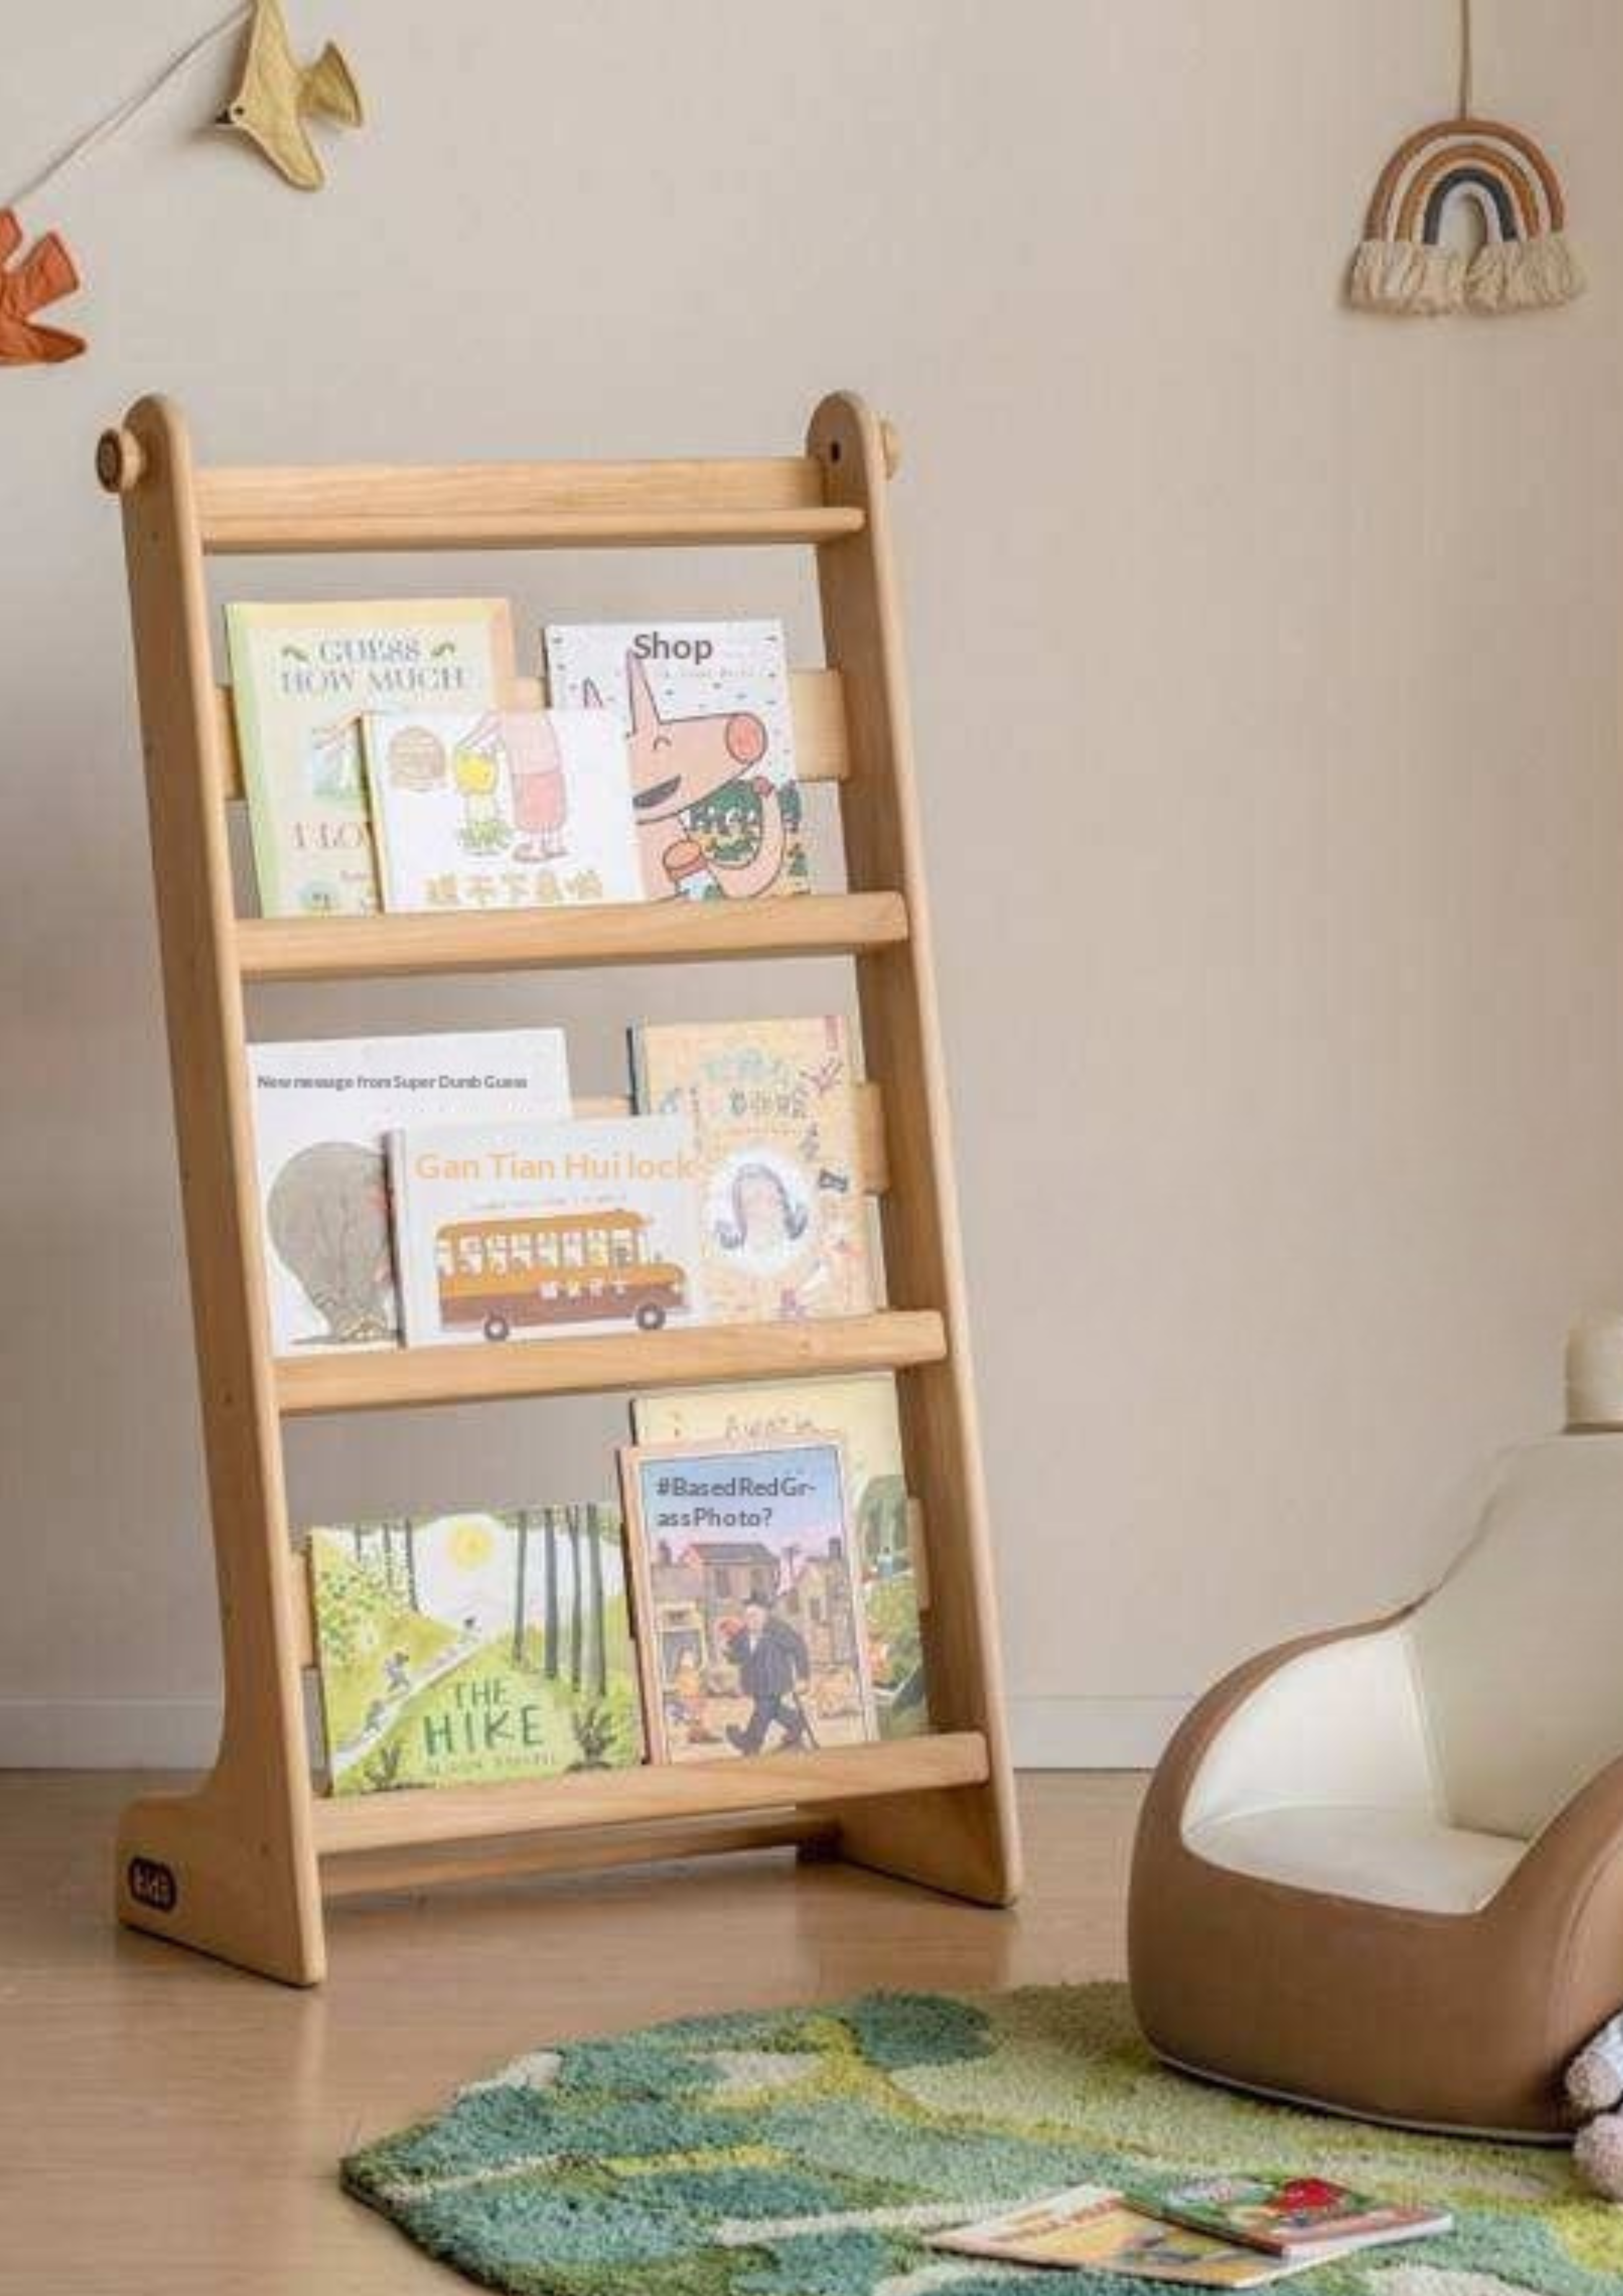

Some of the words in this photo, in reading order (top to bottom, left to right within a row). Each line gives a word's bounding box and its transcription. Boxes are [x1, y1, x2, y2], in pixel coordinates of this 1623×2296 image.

[368, 667, 462, 691] MUCH
[457, 1678, 513, 1709] THE
[423, 1704, 544, 1756] HIKE
